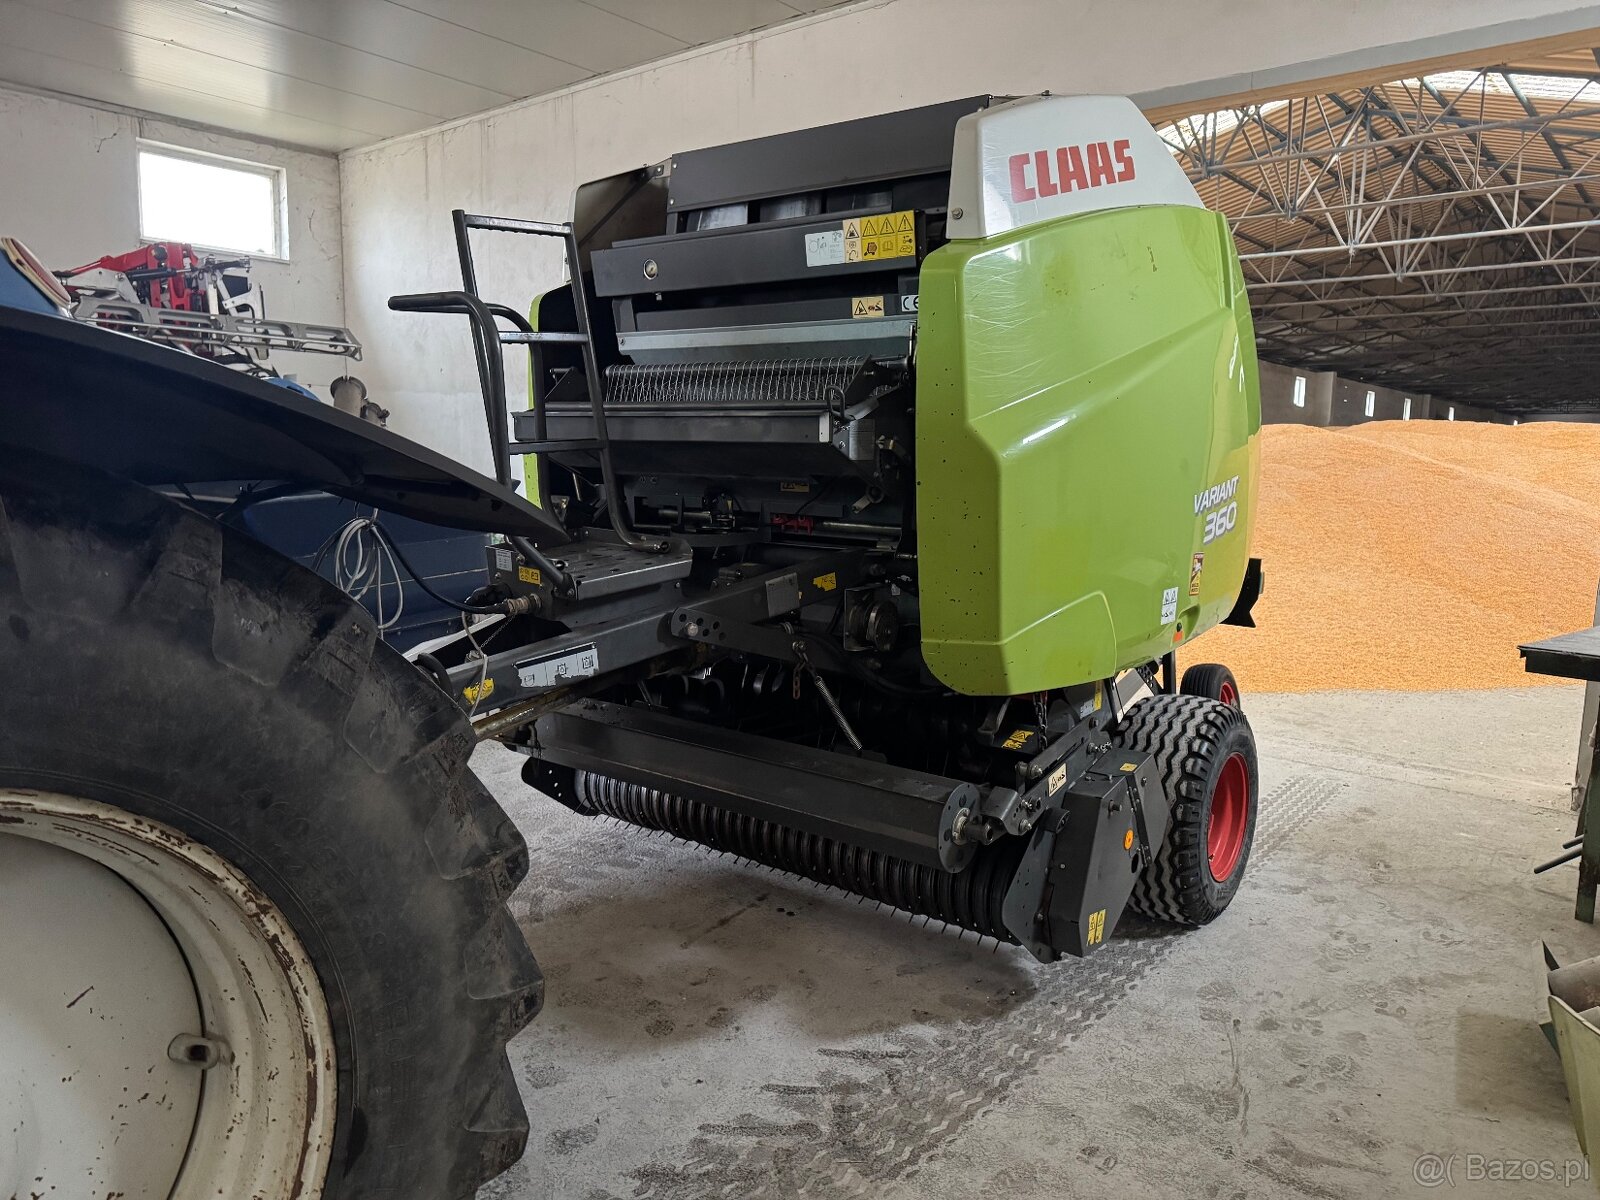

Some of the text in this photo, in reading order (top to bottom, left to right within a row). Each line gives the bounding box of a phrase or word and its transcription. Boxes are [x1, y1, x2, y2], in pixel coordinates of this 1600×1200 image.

[1009, 139, 1136, 204] CLAAS
[1194, 476, 1239, 513] VARIANT
[1203, 502, 1237, 543] 360
